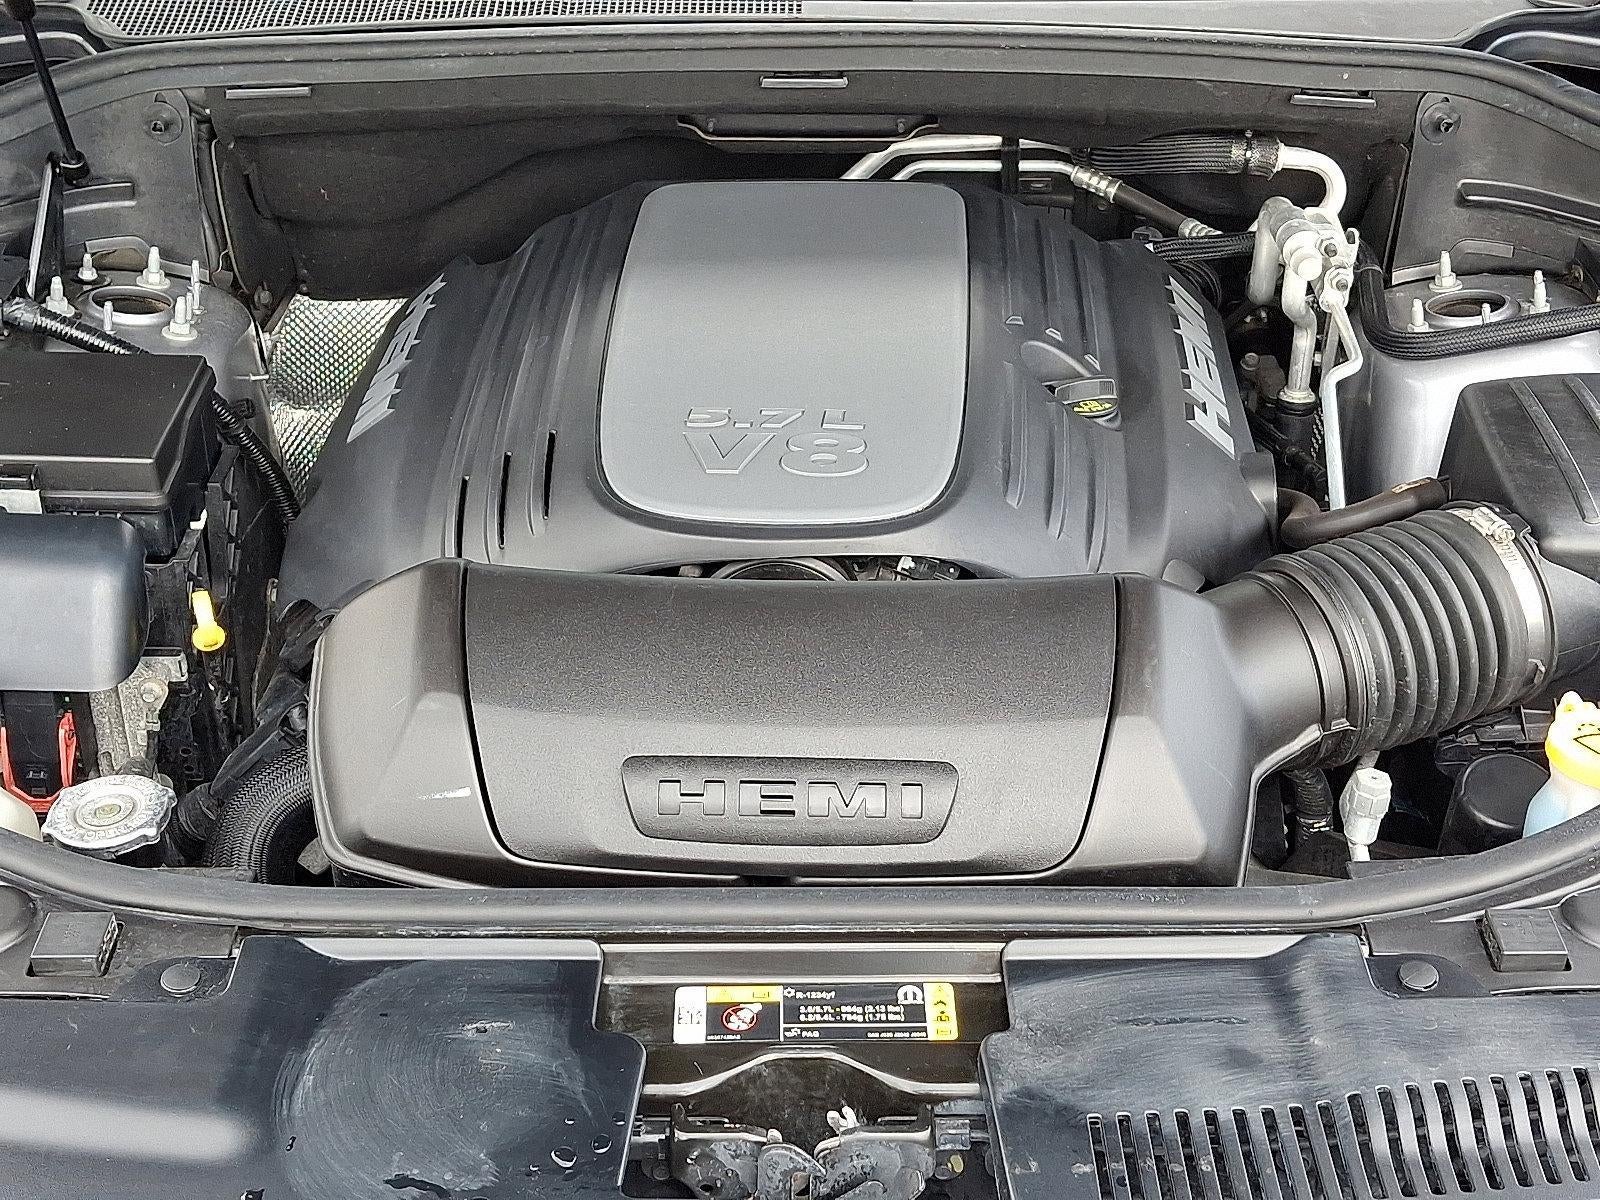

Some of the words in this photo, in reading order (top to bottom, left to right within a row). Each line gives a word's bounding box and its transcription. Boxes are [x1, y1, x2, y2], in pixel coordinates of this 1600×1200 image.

[1164, 274, 1236, 461] HEMI
[682, 431, 870, 478] V8
[657, 778, 924, 820] HEMI
